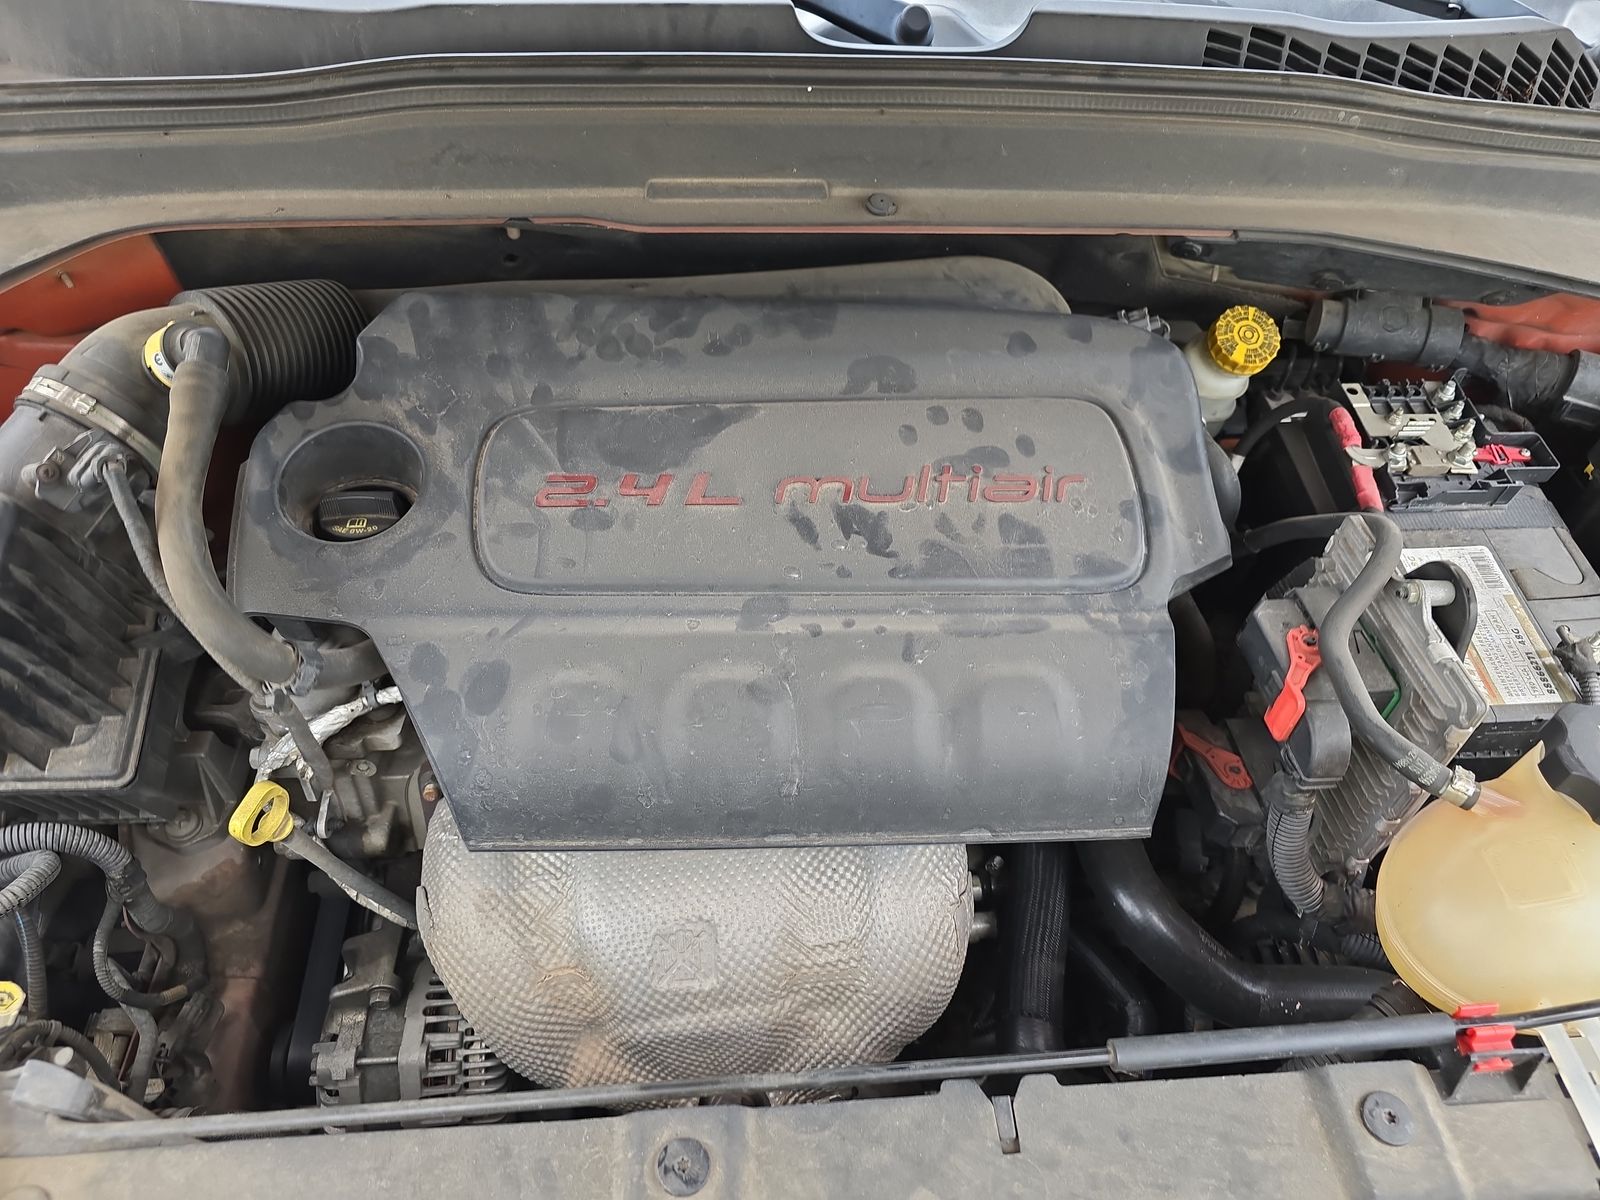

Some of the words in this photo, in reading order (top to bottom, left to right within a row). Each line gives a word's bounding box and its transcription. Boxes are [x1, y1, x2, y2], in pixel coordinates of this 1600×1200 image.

[774, 463, 1086, 506] multiair
[1511, 628, 1526, 646] 48G
[1524, 651, 1556, 694] 88866271
